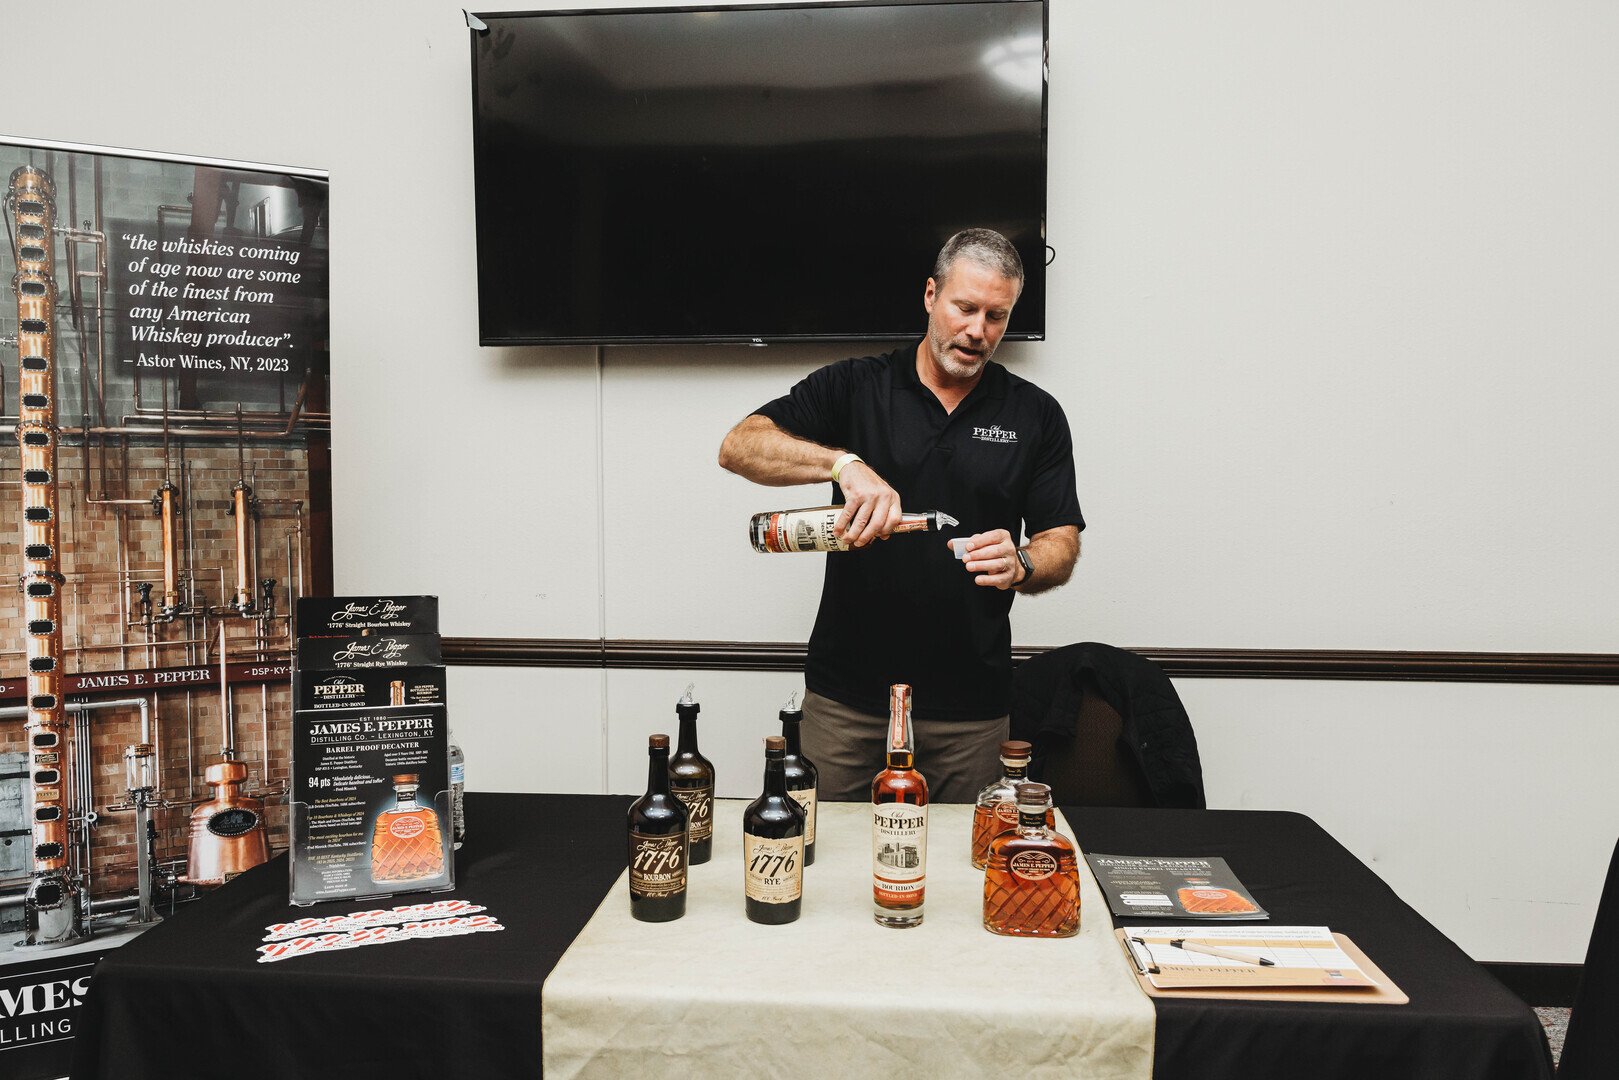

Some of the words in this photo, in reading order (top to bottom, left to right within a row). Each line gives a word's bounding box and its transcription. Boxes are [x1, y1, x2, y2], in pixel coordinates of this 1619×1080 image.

[122, 233, 158, 251] “the
[162, 238, 234, 257] whiskies
[239, 244, 300, 265] coming
[128, 257, 148, 274] of
[150, 263, 181, 280] age
[186, 264, 222, 278] now
[227, 266, 254, 280] are
[258, 268, 301, 284] some
[129, 279, 149, 296] of
[152, 282, 178, 297] the
[182, 283, 230, 301] finest
[234, 286, 274, 304] from
[129, 306, 162, 322] any
[167, 305, 251, 324] American
[131, 325, 202, 346] Whiskey
[206, 331, 294, 348] producer”.
[136, 353, 175, 369] Astor
[179, 355, 227, 372] Wines,
[230, 357, 254, 373] NY,
[257, 358, 289, 372] 2023
[973, 427, 1018, 440] PEPPER
[331, 602, 369, 621] James
[378, 599, 407, 620] Pepper
[333, 641, 371, 660] James
[381, 638, 410, 659] Pepper
[77, 674, 129, 689] JAMES
[134, 673, 148, 684] E.
[154, 669, 211, 683] PEPPER
[314, 683, 365, 695] PEPPER
[314, 701, 366, 709] BOTTLED-IN-BOND
[310, 722, 361, 736] JAMES
[364, 722, 376, 732] E.
[378, 718, 434, 731] PEPPER
[326, 745, 355, 754] BARREL
[355, 744, 380, 752] PROOF
[381, 742, 420, 750] DECANTER
[308, 777, 319, 788] 94
[320, 777, 331, 788] pts
[874, 813, 924, 829] PEPPER
[880, 828, 916, 836] DISTILLERY
[749, 851, 798, 877] 1776
[1157, 860, 1212, 868] PEPPER
[643, 873, 671, 881] BOURBON
[881, 883, 915, 891] BOURBON
